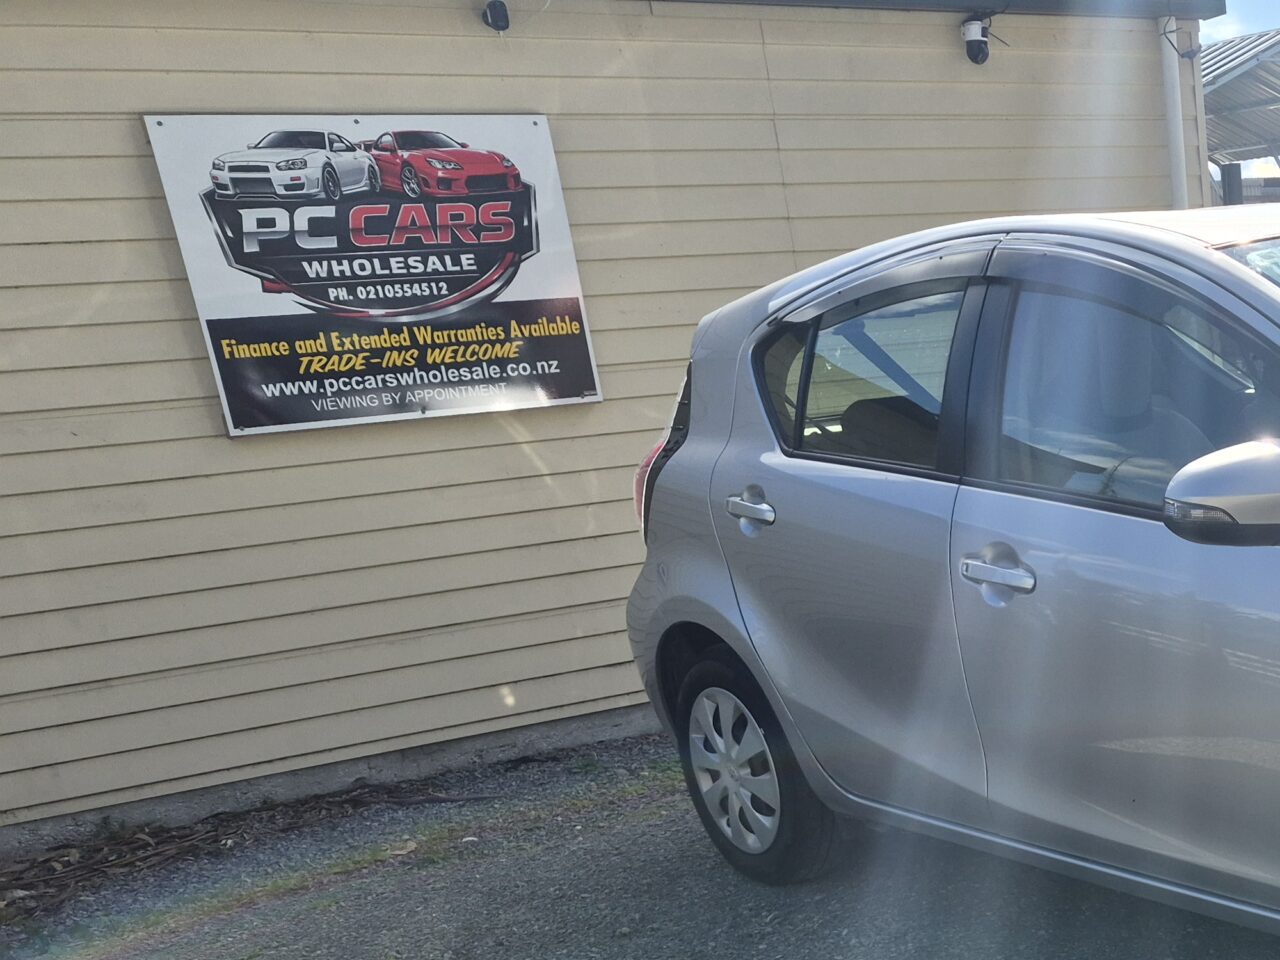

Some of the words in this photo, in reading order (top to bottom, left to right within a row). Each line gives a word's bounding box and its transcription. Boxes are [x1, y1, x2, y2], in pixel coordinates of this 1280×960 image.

[238, 205, 338, 253] PC
[349, 201, 516, 247] CARS
[302, 253, 477, 278] WHOLESALE
[328, 286, 353, 301] PH.
[356, 281, 449, 299] 0210554512
[220, 338, 290, 360] Finance
[295, 331, 328, 354] and
[330, 325, 411, 352] Extended
[413, 322, 505, 346] Warranties
[510, 315, 581, 338] Available
[299, 348, 419, 375] TRADE-INS
[426, 341, 524, 365] WELCOME
[261, 359, 561, 398] www.pccarswholesale.co.nz
[311, 394, 378, 412] VIEWING
[381, 391, 402, 406] BY
[405, 382, 508, 403] APPOINTMENT
